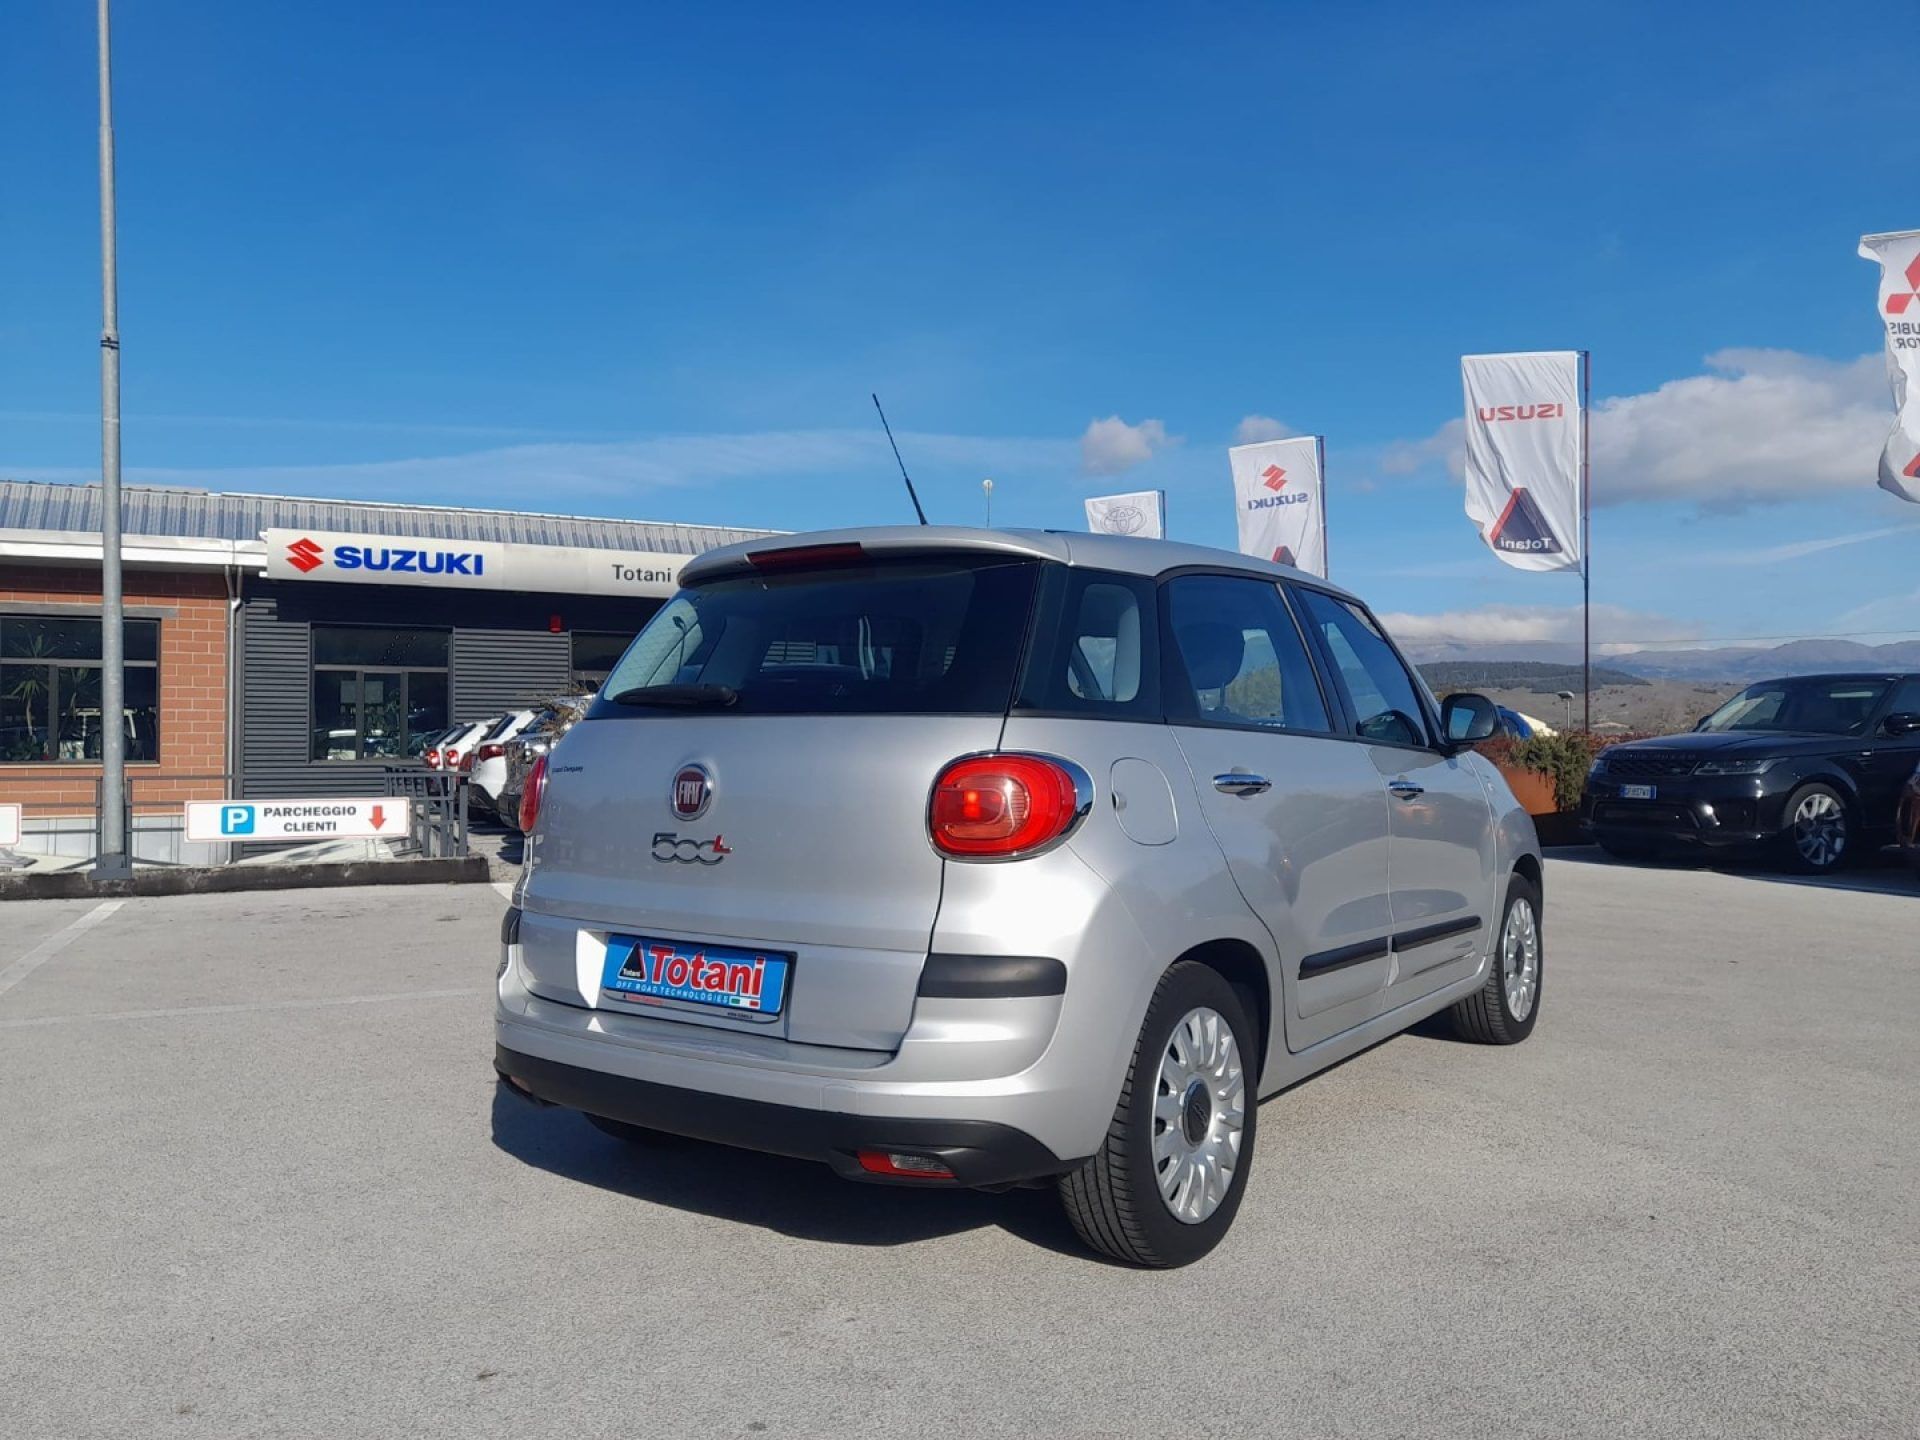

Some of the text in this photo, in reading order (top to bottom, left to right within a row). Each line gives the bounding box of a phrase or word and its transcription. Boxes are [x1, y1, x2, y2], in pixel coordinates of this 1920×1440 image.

[333, 546, 484, 576] SUZUKI
[612, 564, 672, 584] Totani
[678, 780, 702, 805] FIAT
[227, 808, 249, 833] P
[263, 806, 357, 817] PARCHEGGIO
[283, 821, 337, 832] CLIENTI
[649, 946, 765, 997] Totani
[635, 984, 658, 995] ROAD
[660, 987, 730, 1005] TECHNOLOGIES
